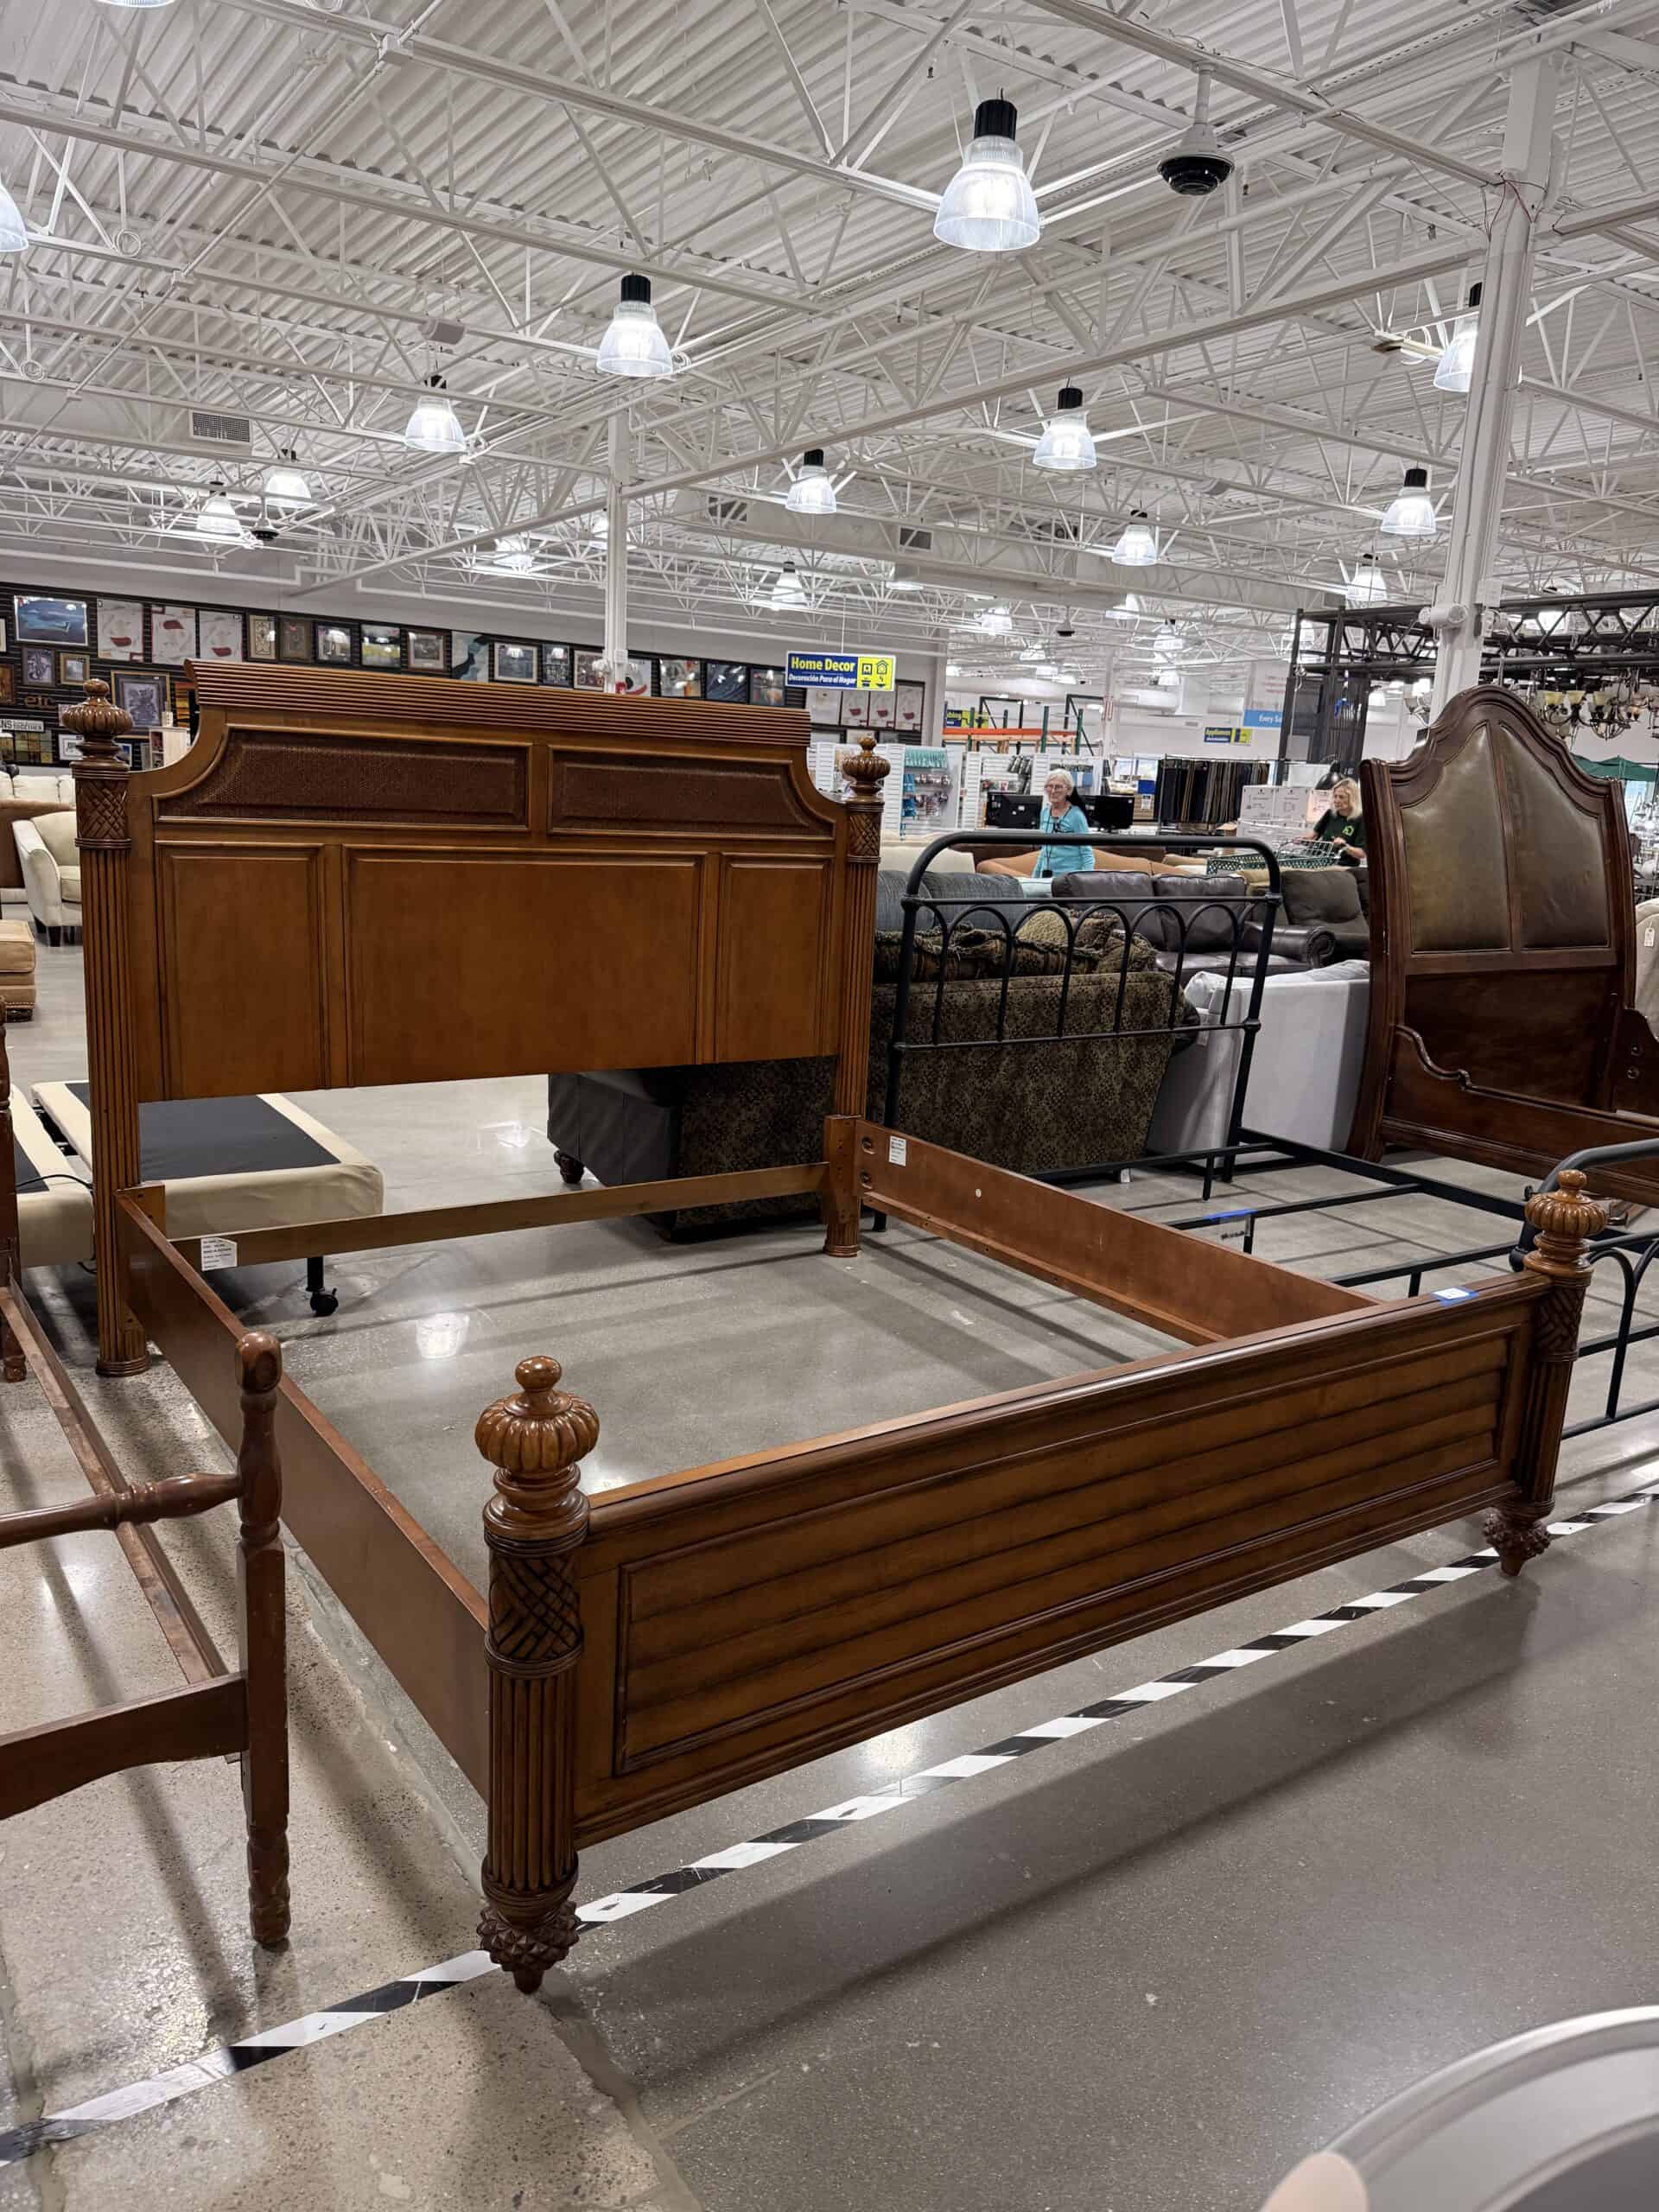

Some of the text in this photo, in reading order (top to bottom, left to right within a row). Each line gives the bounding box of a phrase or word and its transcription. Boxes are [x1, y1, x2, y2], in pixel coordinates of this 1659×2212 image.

[791, 656, 855, 672] Home Decor
[788, 673, 818, 683] Decoración
[819, 675, 833, 683] Para
[839, 676, 856, 685] Hogar
